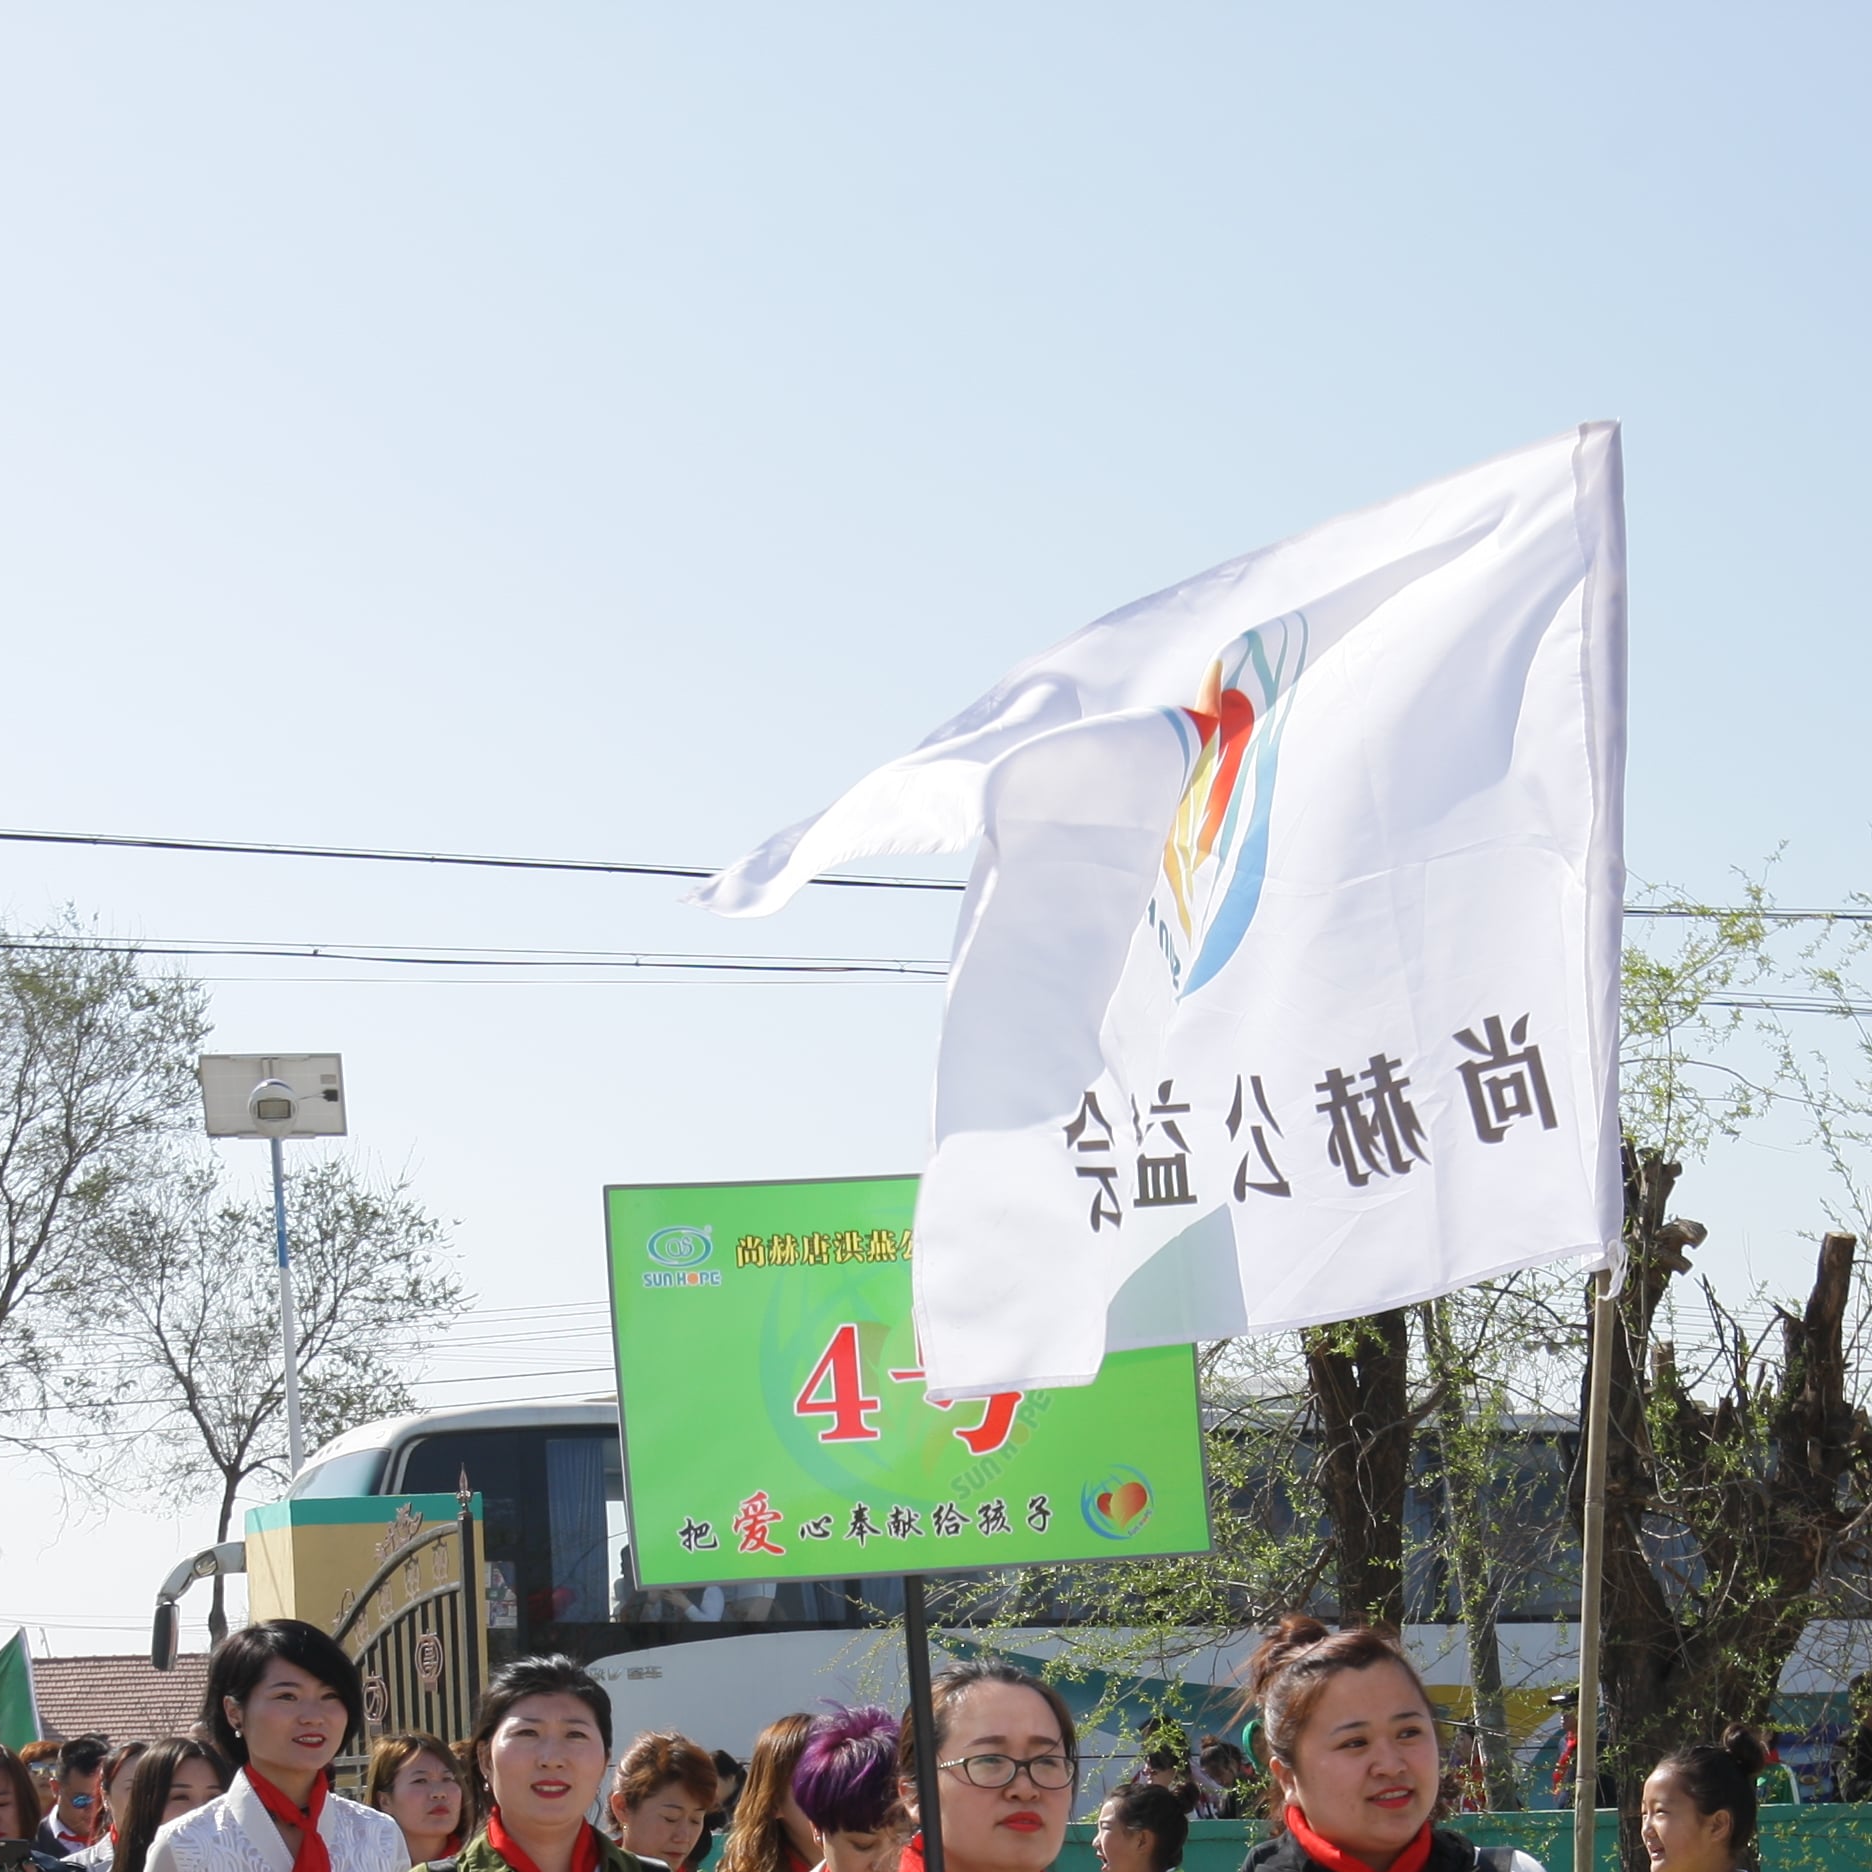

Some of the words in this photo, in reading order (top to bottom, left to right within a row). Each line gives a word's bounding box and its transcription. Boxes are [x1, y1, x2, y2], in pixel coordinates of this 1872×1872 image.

[642, 1272, 674, 1288] SUN
[675, 1271, 721, 1287] HOPE
[678, 1490, 1054, 1556] 把爱心奉献给孩子
